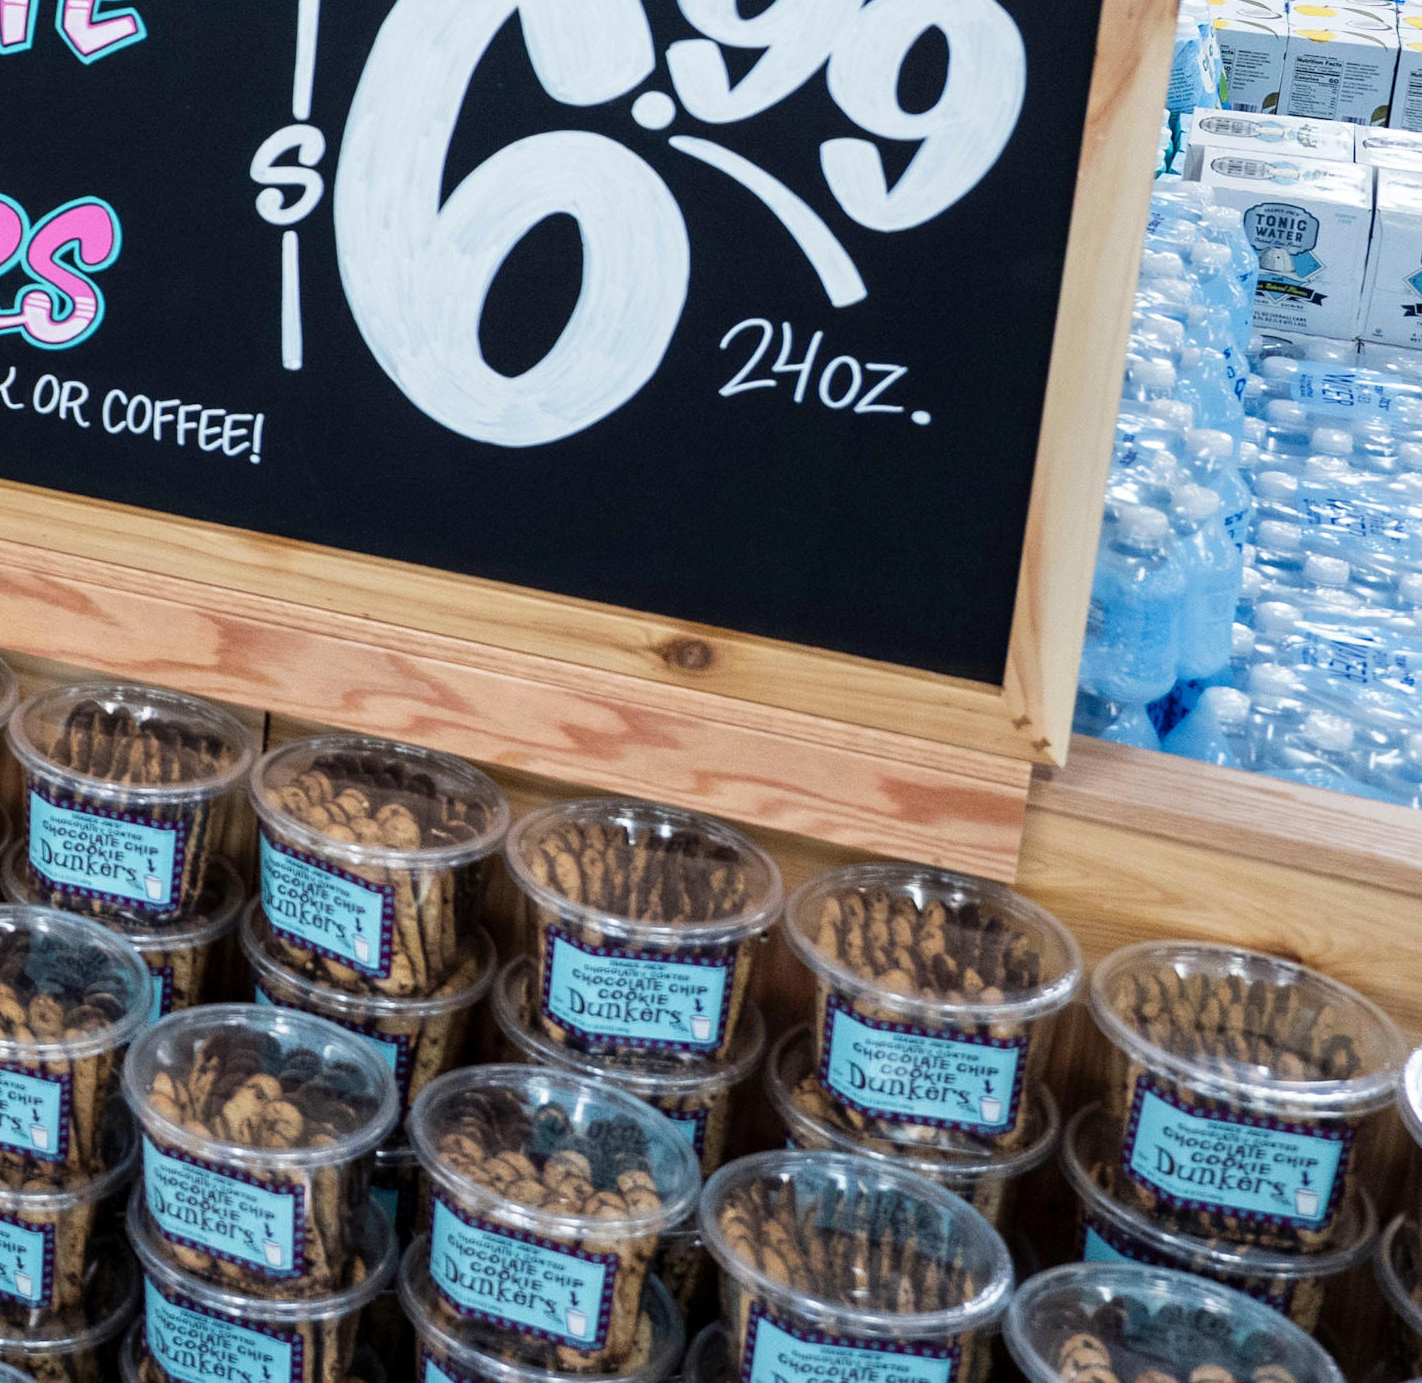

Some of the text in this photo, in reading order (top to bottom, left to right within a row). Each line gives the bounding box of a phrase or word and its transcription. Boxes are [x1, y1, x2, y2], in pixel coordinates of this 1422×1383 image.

[1255, 226, 1304, 244] WATER
[1256, 213, 1308, 231] TONIC
[32, 373, 91, 429] OR
[101, 388, 267, 464] COFFEE!
[40, 836, 137, 883] Dunkers
[566, 985, 683, 1025] Dunkers
[846, 1059, 972, 1105] Dunkers
[1162, 1125, 1320, 1170] CHOCOLATE CHIP
[1190, 1151, 1272, 1176] COOKIE
[1153, 1144, 1287, 1197] Dunkers
